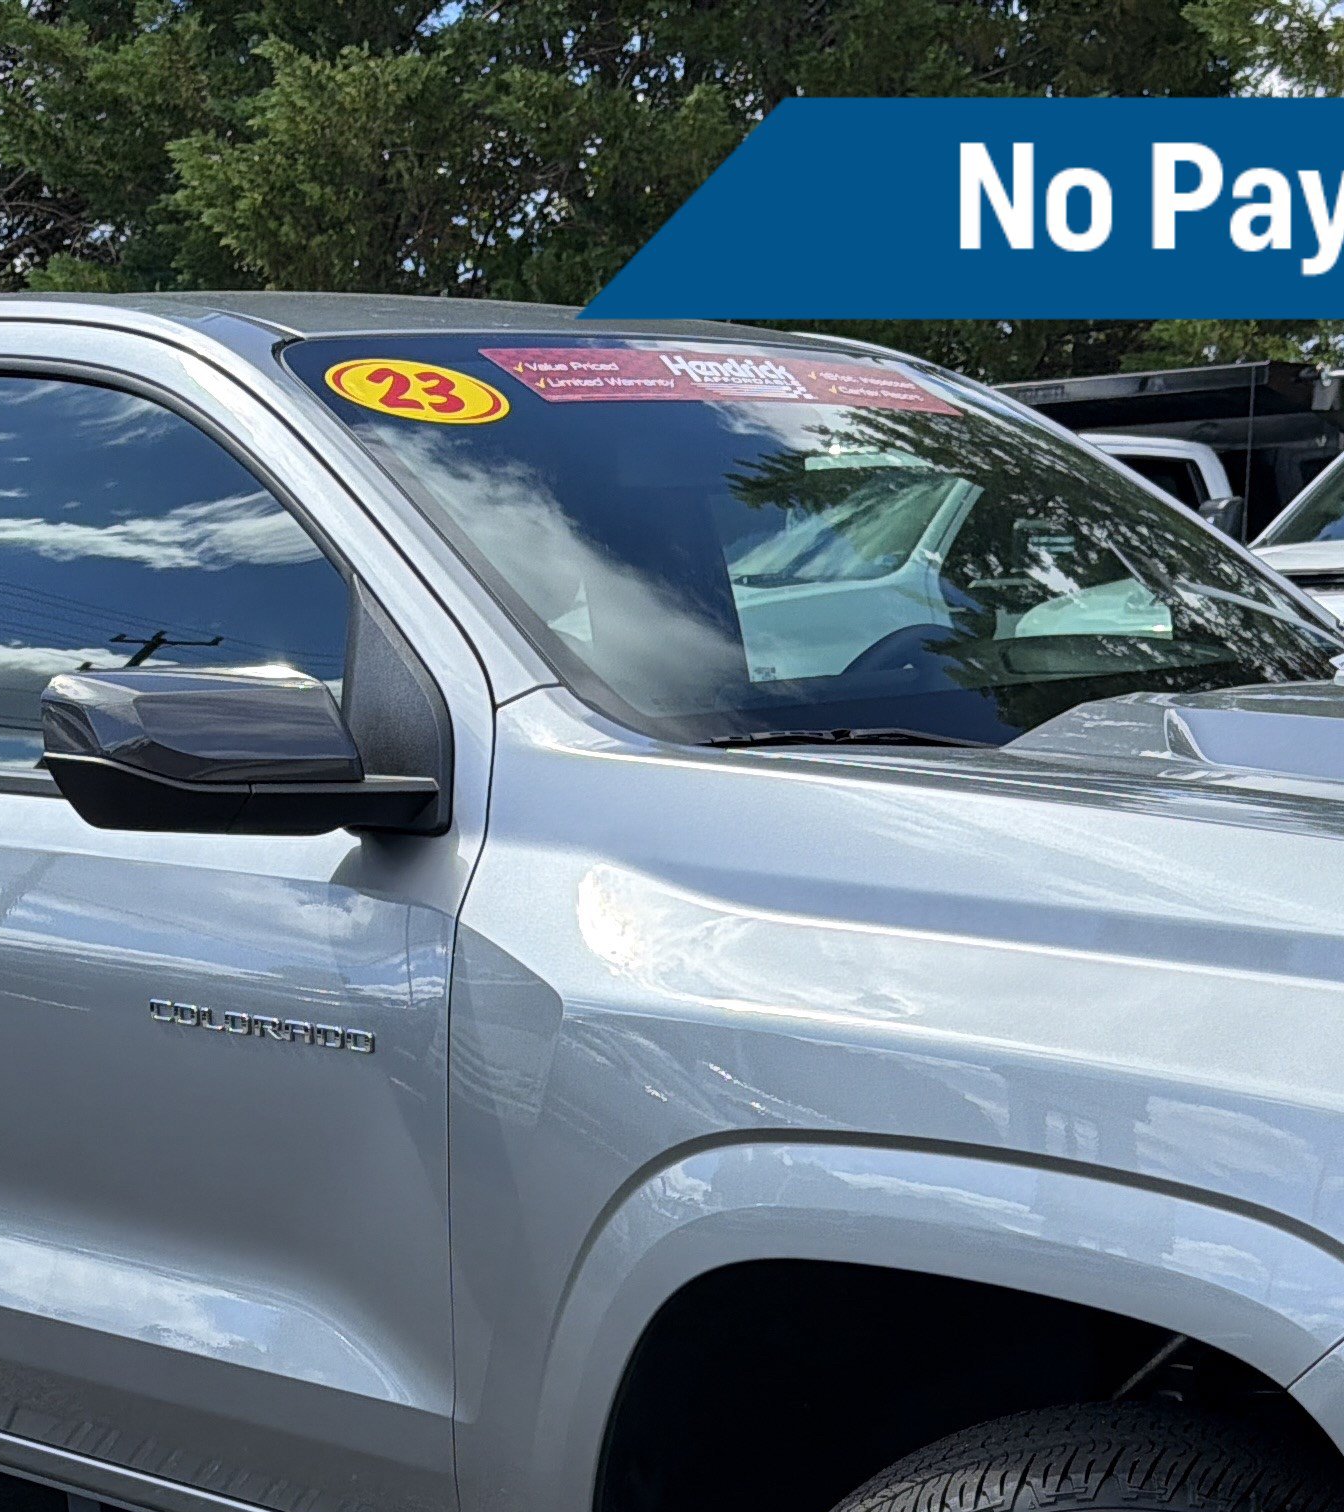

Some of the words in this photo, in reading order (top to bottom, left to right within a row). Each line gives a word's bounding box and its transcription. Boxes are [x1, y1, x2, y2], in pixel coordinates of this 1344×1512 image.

[525, 361, 568, 372] Value
[570, 361, 619, 371] Priced
[659, 355, 796, 383] Hendrick
[366, 368, 465, 413] 23
[547, 377, 604, 388] Limited
[604, 377, 675, 388] Warranty
[150, 998, 375, 1053] COLORADO
